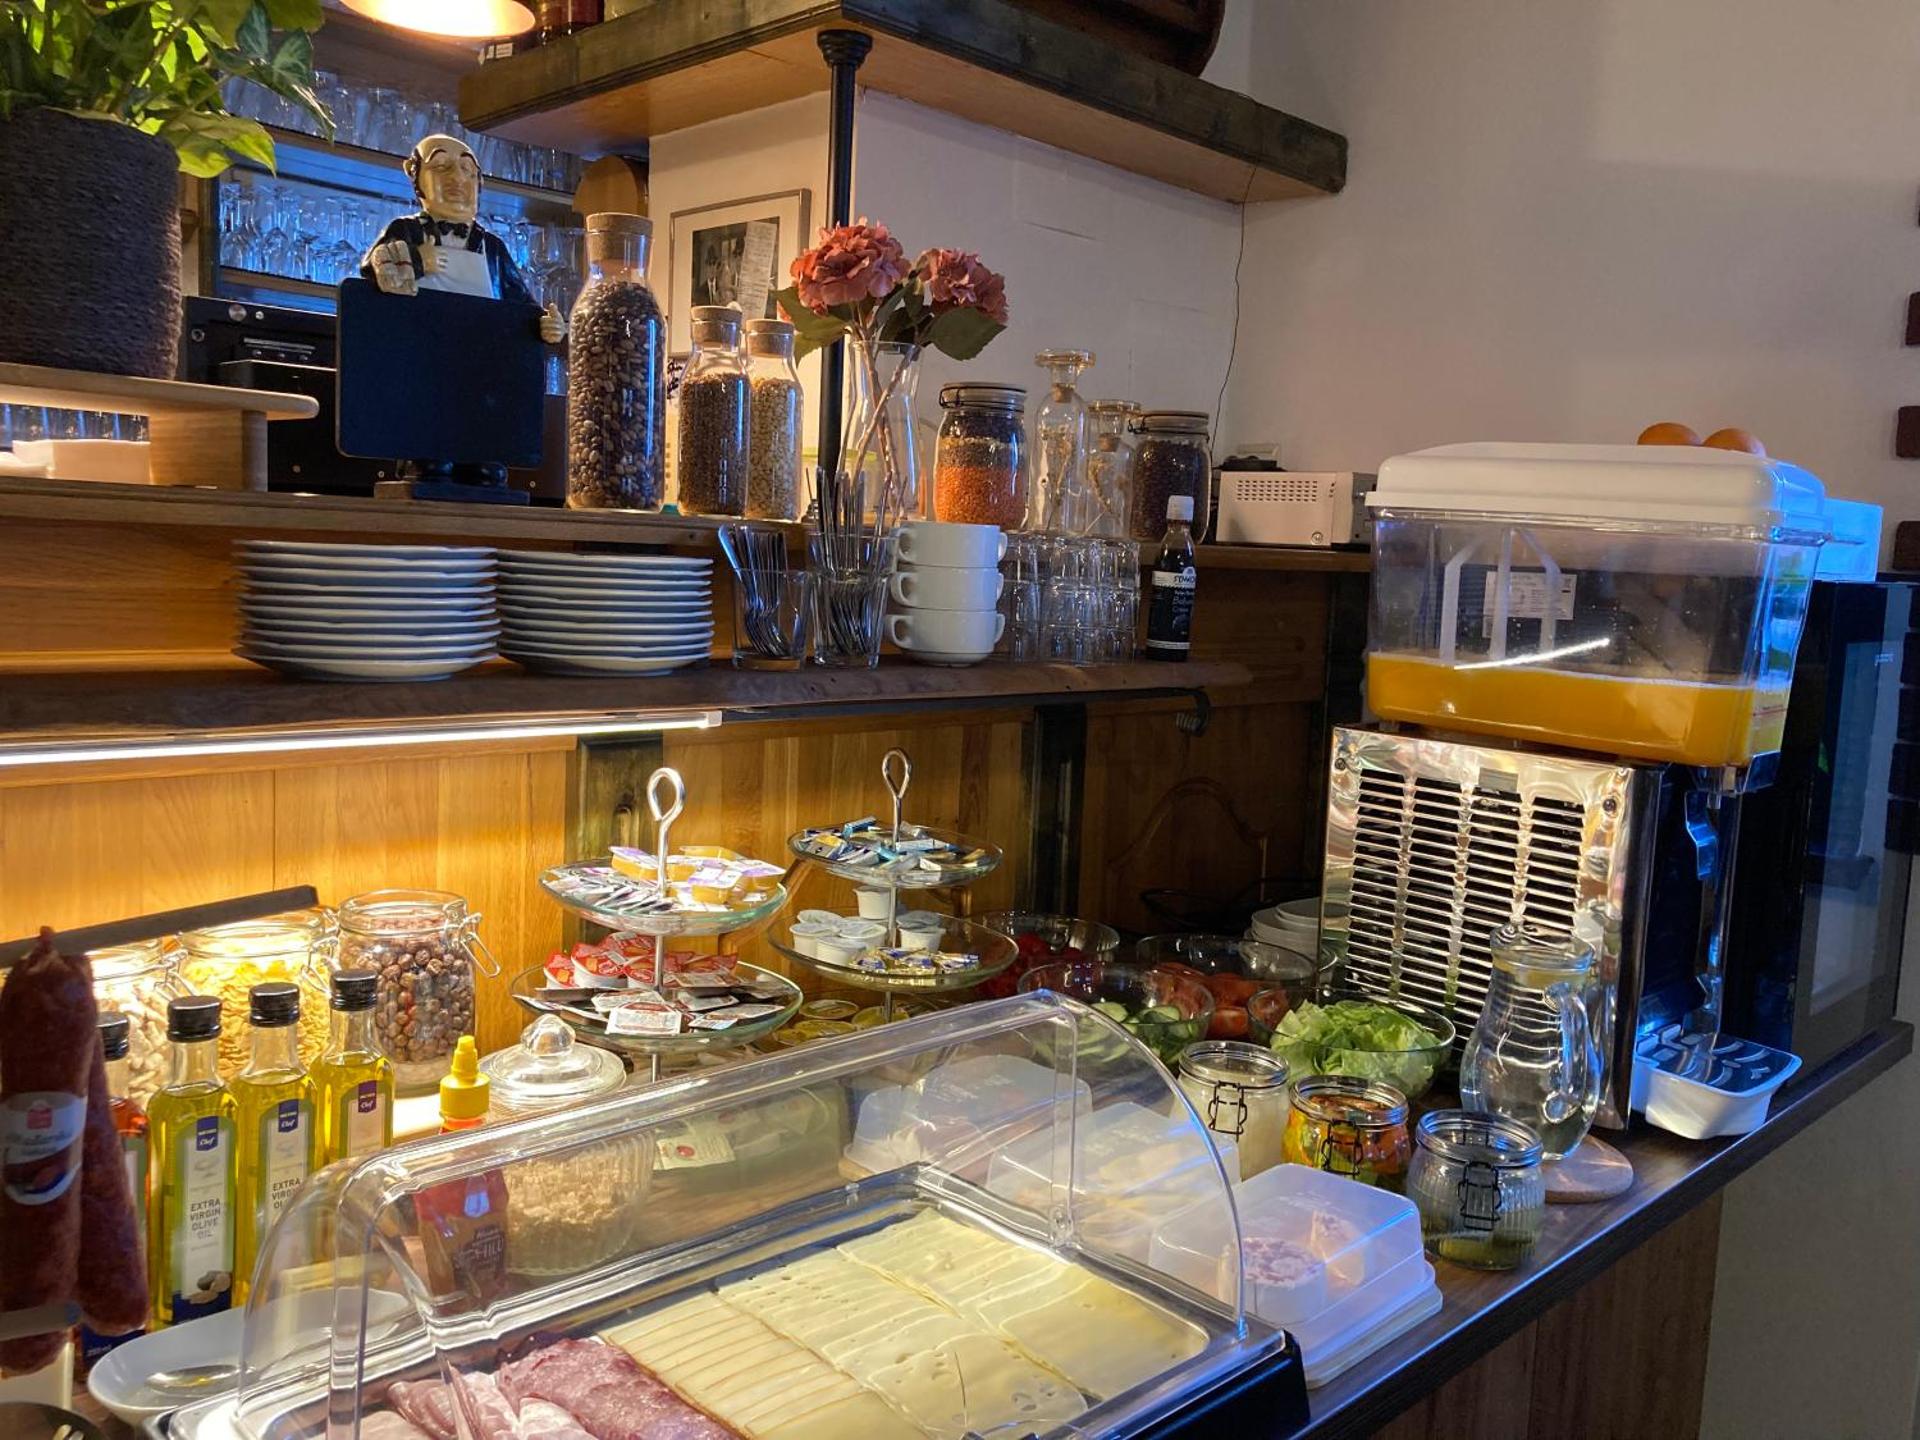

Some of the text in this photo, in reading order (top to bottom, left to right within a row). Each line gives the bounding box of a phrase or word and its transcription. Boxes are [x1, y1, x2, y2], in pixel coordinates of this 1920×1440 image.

[272, 1178, 301, 1192] EXTRA
[190, 1199, 221, 1212] EXTRA
[189, 1208, 221, 1221] VIRGIN
[191, 1217, 219, 1231] OLIVE
